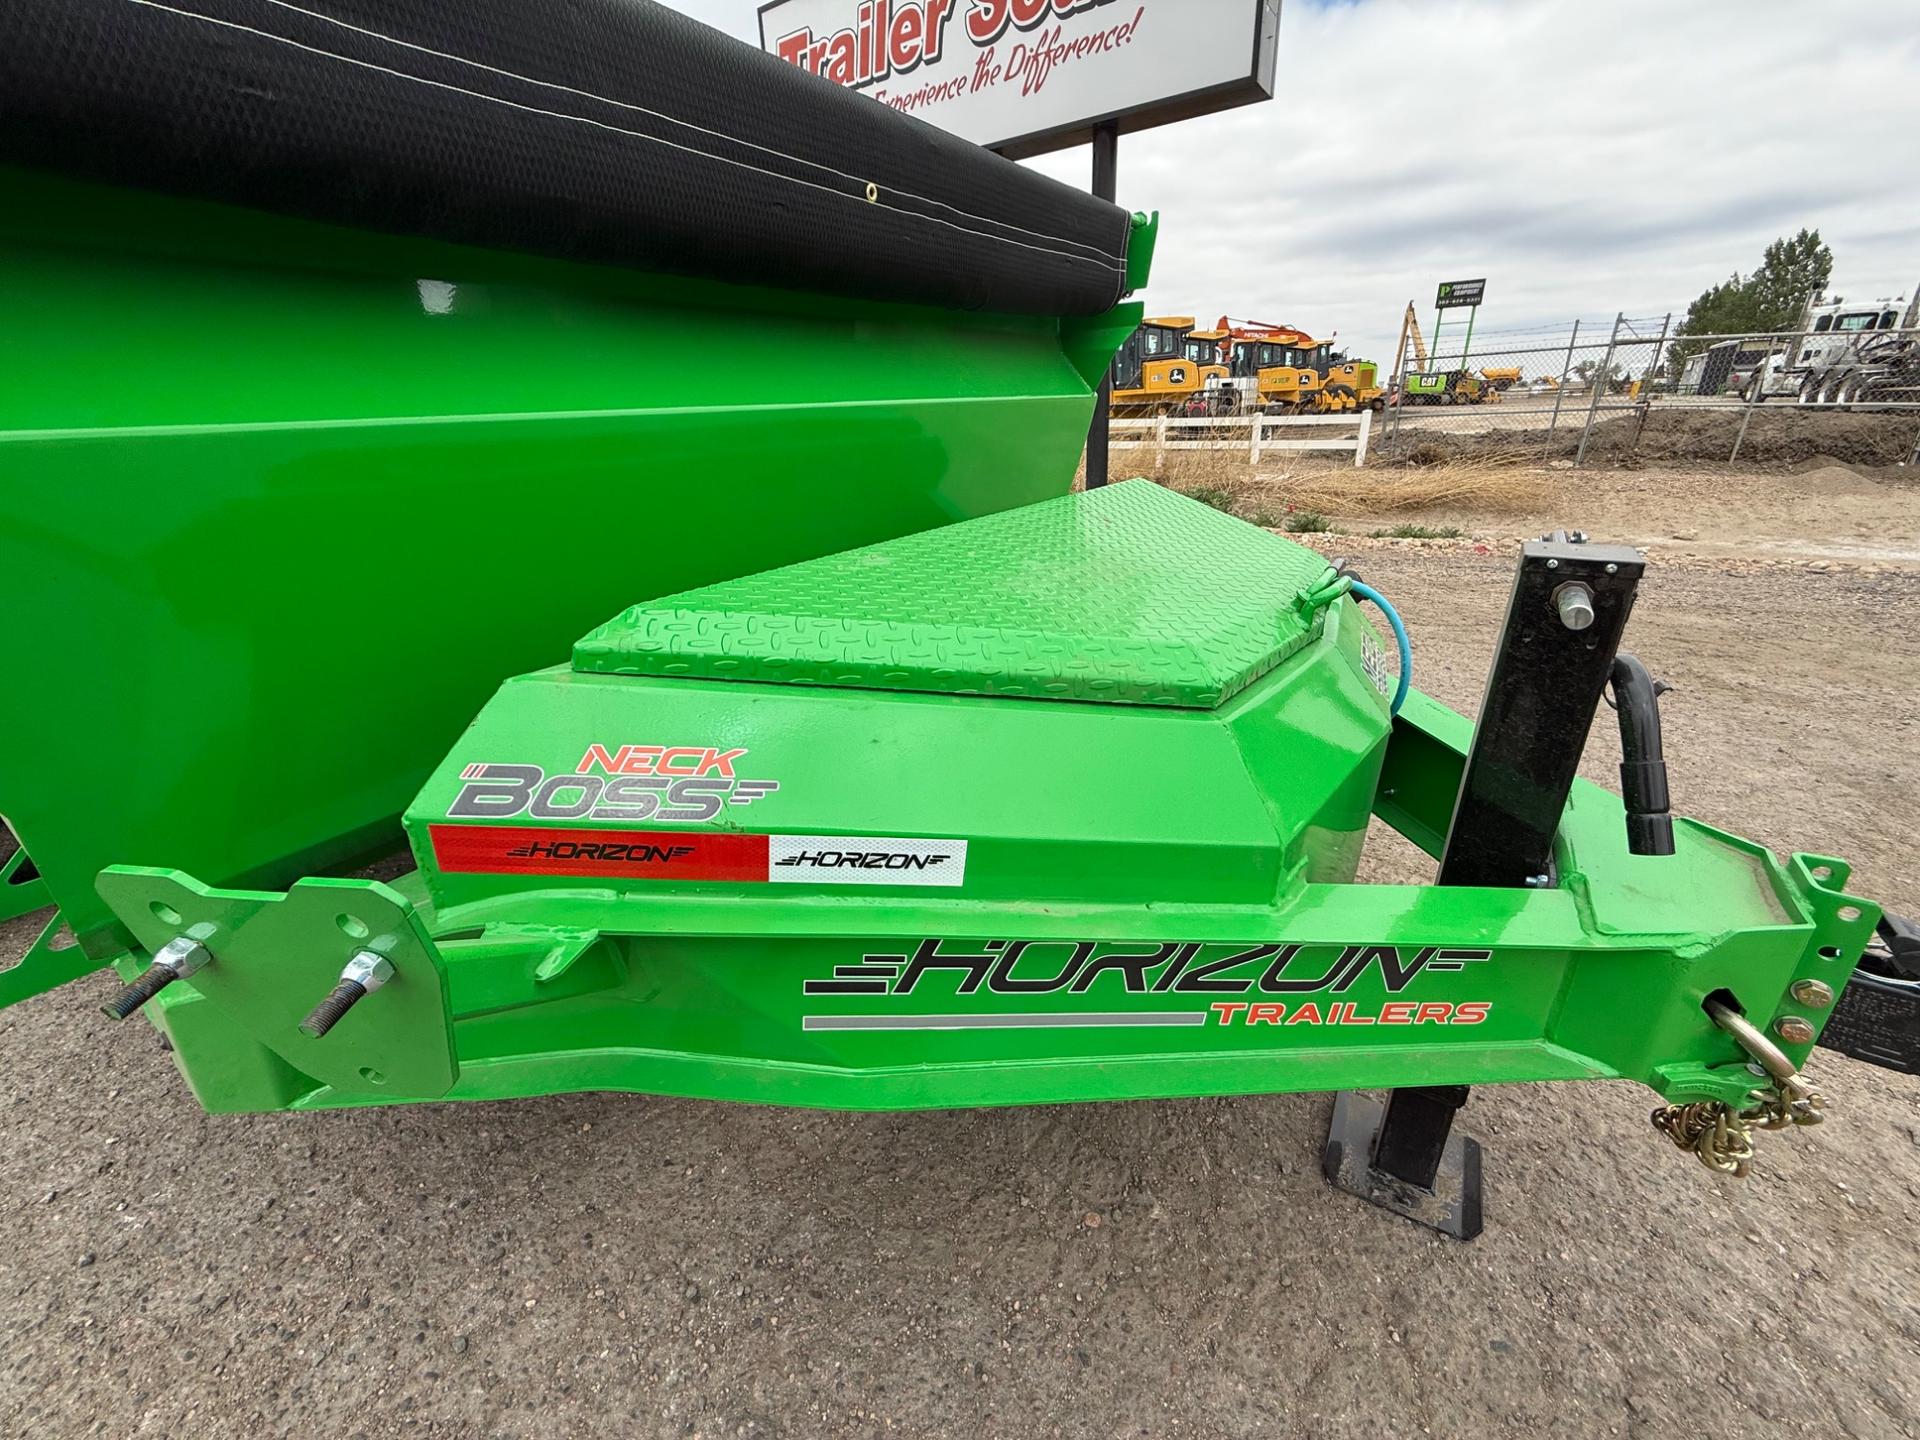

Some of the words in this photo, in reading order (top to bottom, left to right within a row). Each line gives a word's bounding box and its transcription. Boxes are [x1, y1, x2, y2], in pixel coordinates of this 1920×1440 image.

[970, 46, 1001, 93] the
[1003, 6, 1145, 97] Difference!
[1421, 377, 1437, 387] CAT
[575, 744, 748, 778] NECK
[445, 763, 734, 822] BOSS
[529, 841, 674, 863] HORIZON
[795, 850, 932, 870] HORIZON
[889, 938, 1430, 995] HORIZON
[1210, 1001, 1492, 1026] TRAILERS
